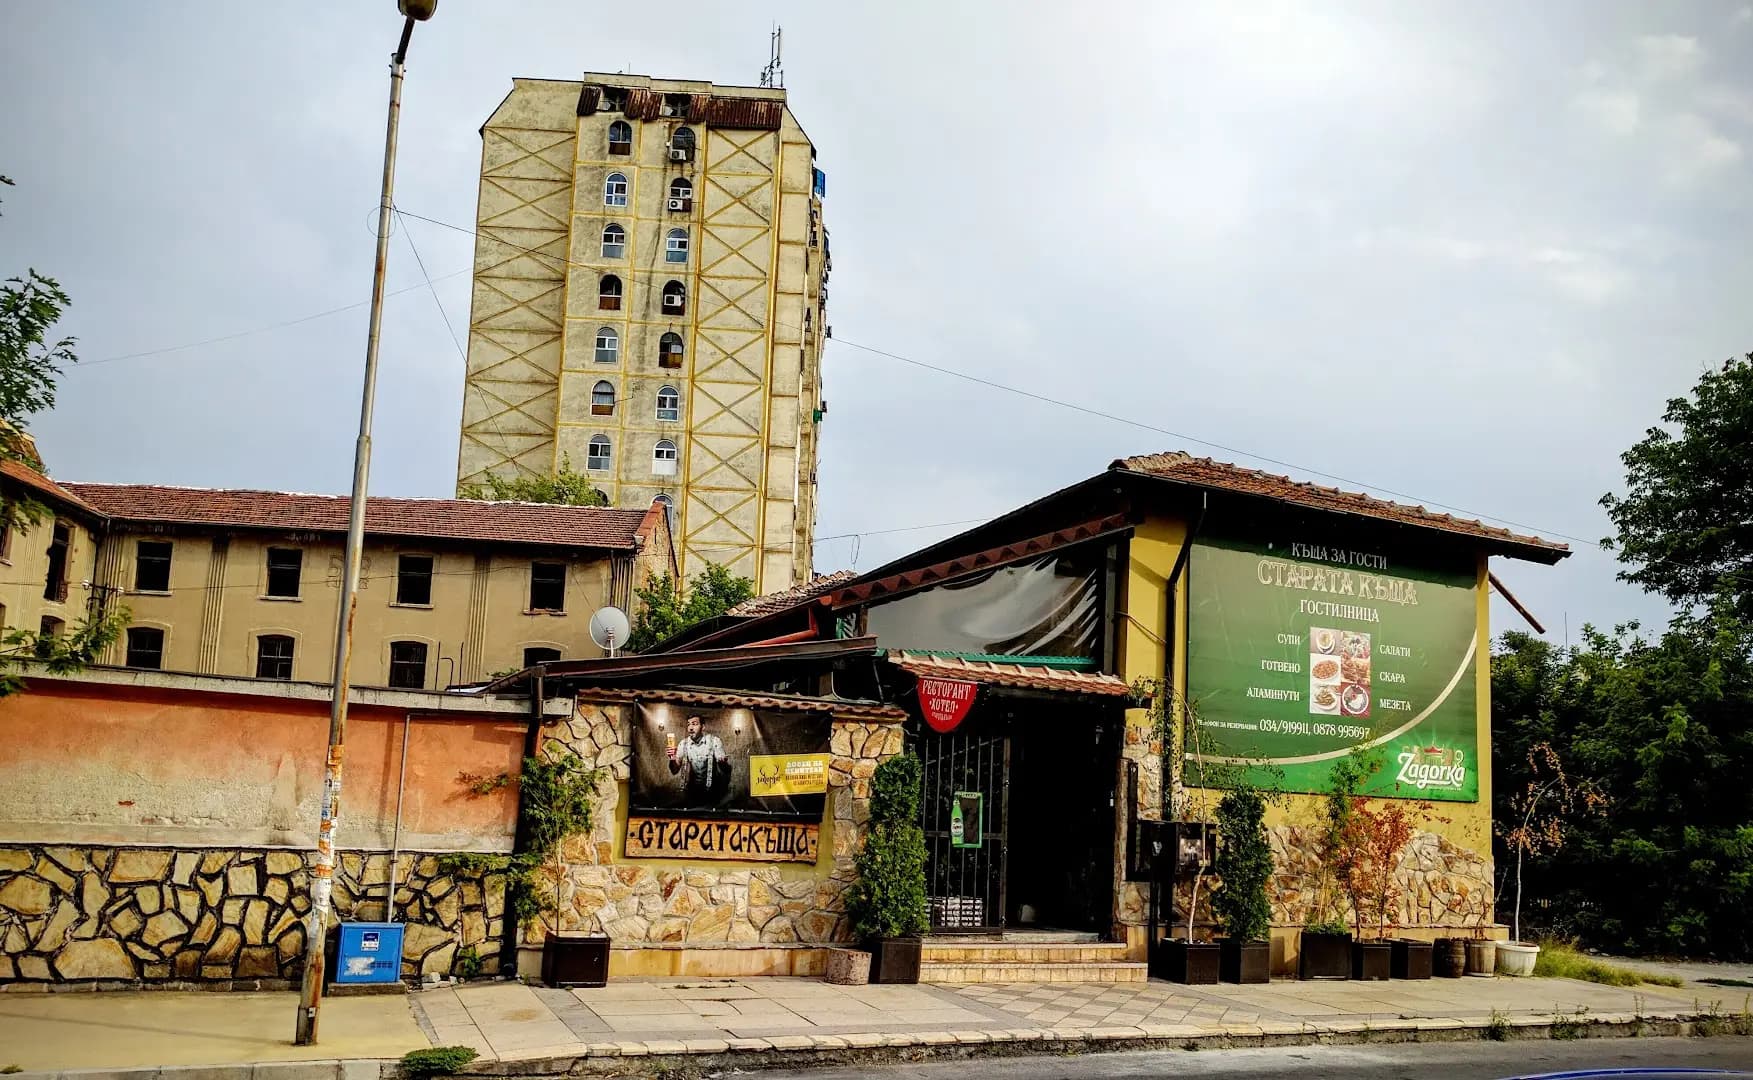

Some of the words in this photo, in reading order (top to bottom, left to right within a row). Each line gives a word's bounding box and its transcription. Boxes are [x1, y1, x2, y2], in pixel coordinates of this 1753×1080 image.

[1292, 542, 1328, 561] КЪЩА
[1331, 548, 1347, 564] ЗА
[1349, 550, 1387, 570] ГОСТИ
[1257, 560, 1355, 596] СТАРАТА
[1358, 574, 1418, 605] КЪЩА
[1300, 599, 1380, 623] ГОСТИЛНИЦА
[1277, 633, 1301, 645] СУПИ
[1379, 644, 1411, 657] САЛАТИ
[1261, 659, 1301, 673] ГОТВЕНО
[1379, 671, 1406, 683] СКАРА
[922, 680, 971, 700] РЕСТОРАНТ
[1246, 687, 1300, 701] АЛАМИНУТИ
[931, 698, 956, 713] ХОТЕЛ
[1379, 698, 1412, 711] МЕЗЕТА
[1313, 722, 1336, 736] 0878
[1338, 725, 1370, 739] 995697
[1396, 750, 1466, 789] Zagorka
[748, 826, 810, 858] КЪЩА
